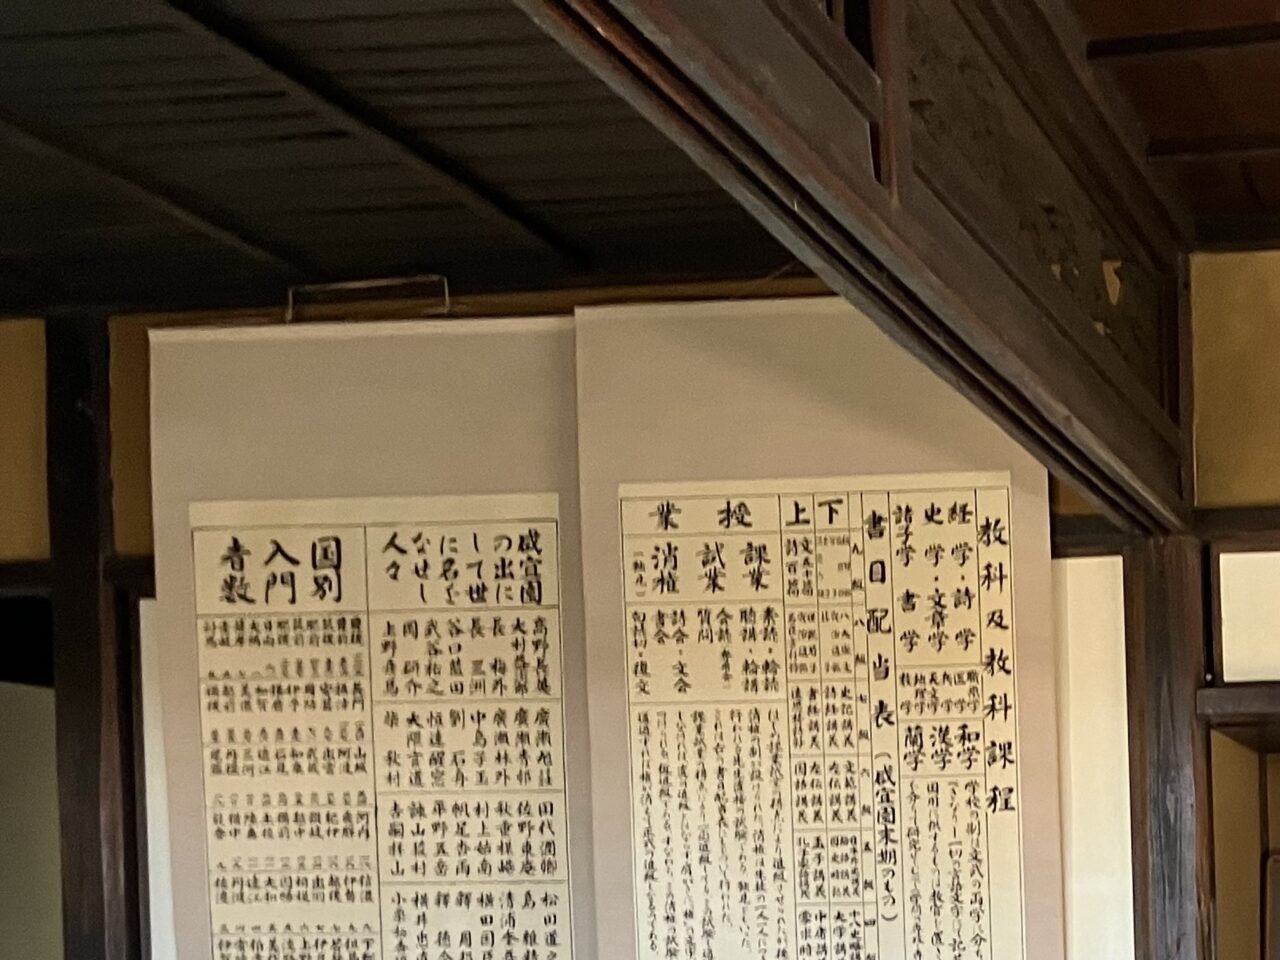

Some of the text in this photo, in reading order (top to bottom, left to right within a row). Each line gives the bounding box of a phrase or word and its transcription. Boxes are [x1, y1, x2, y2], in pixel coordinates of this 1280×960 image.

[785, 500, 811, 526] 上
[817, 498, 844, 525] 下
[264, 538, 301, 605] 入門
